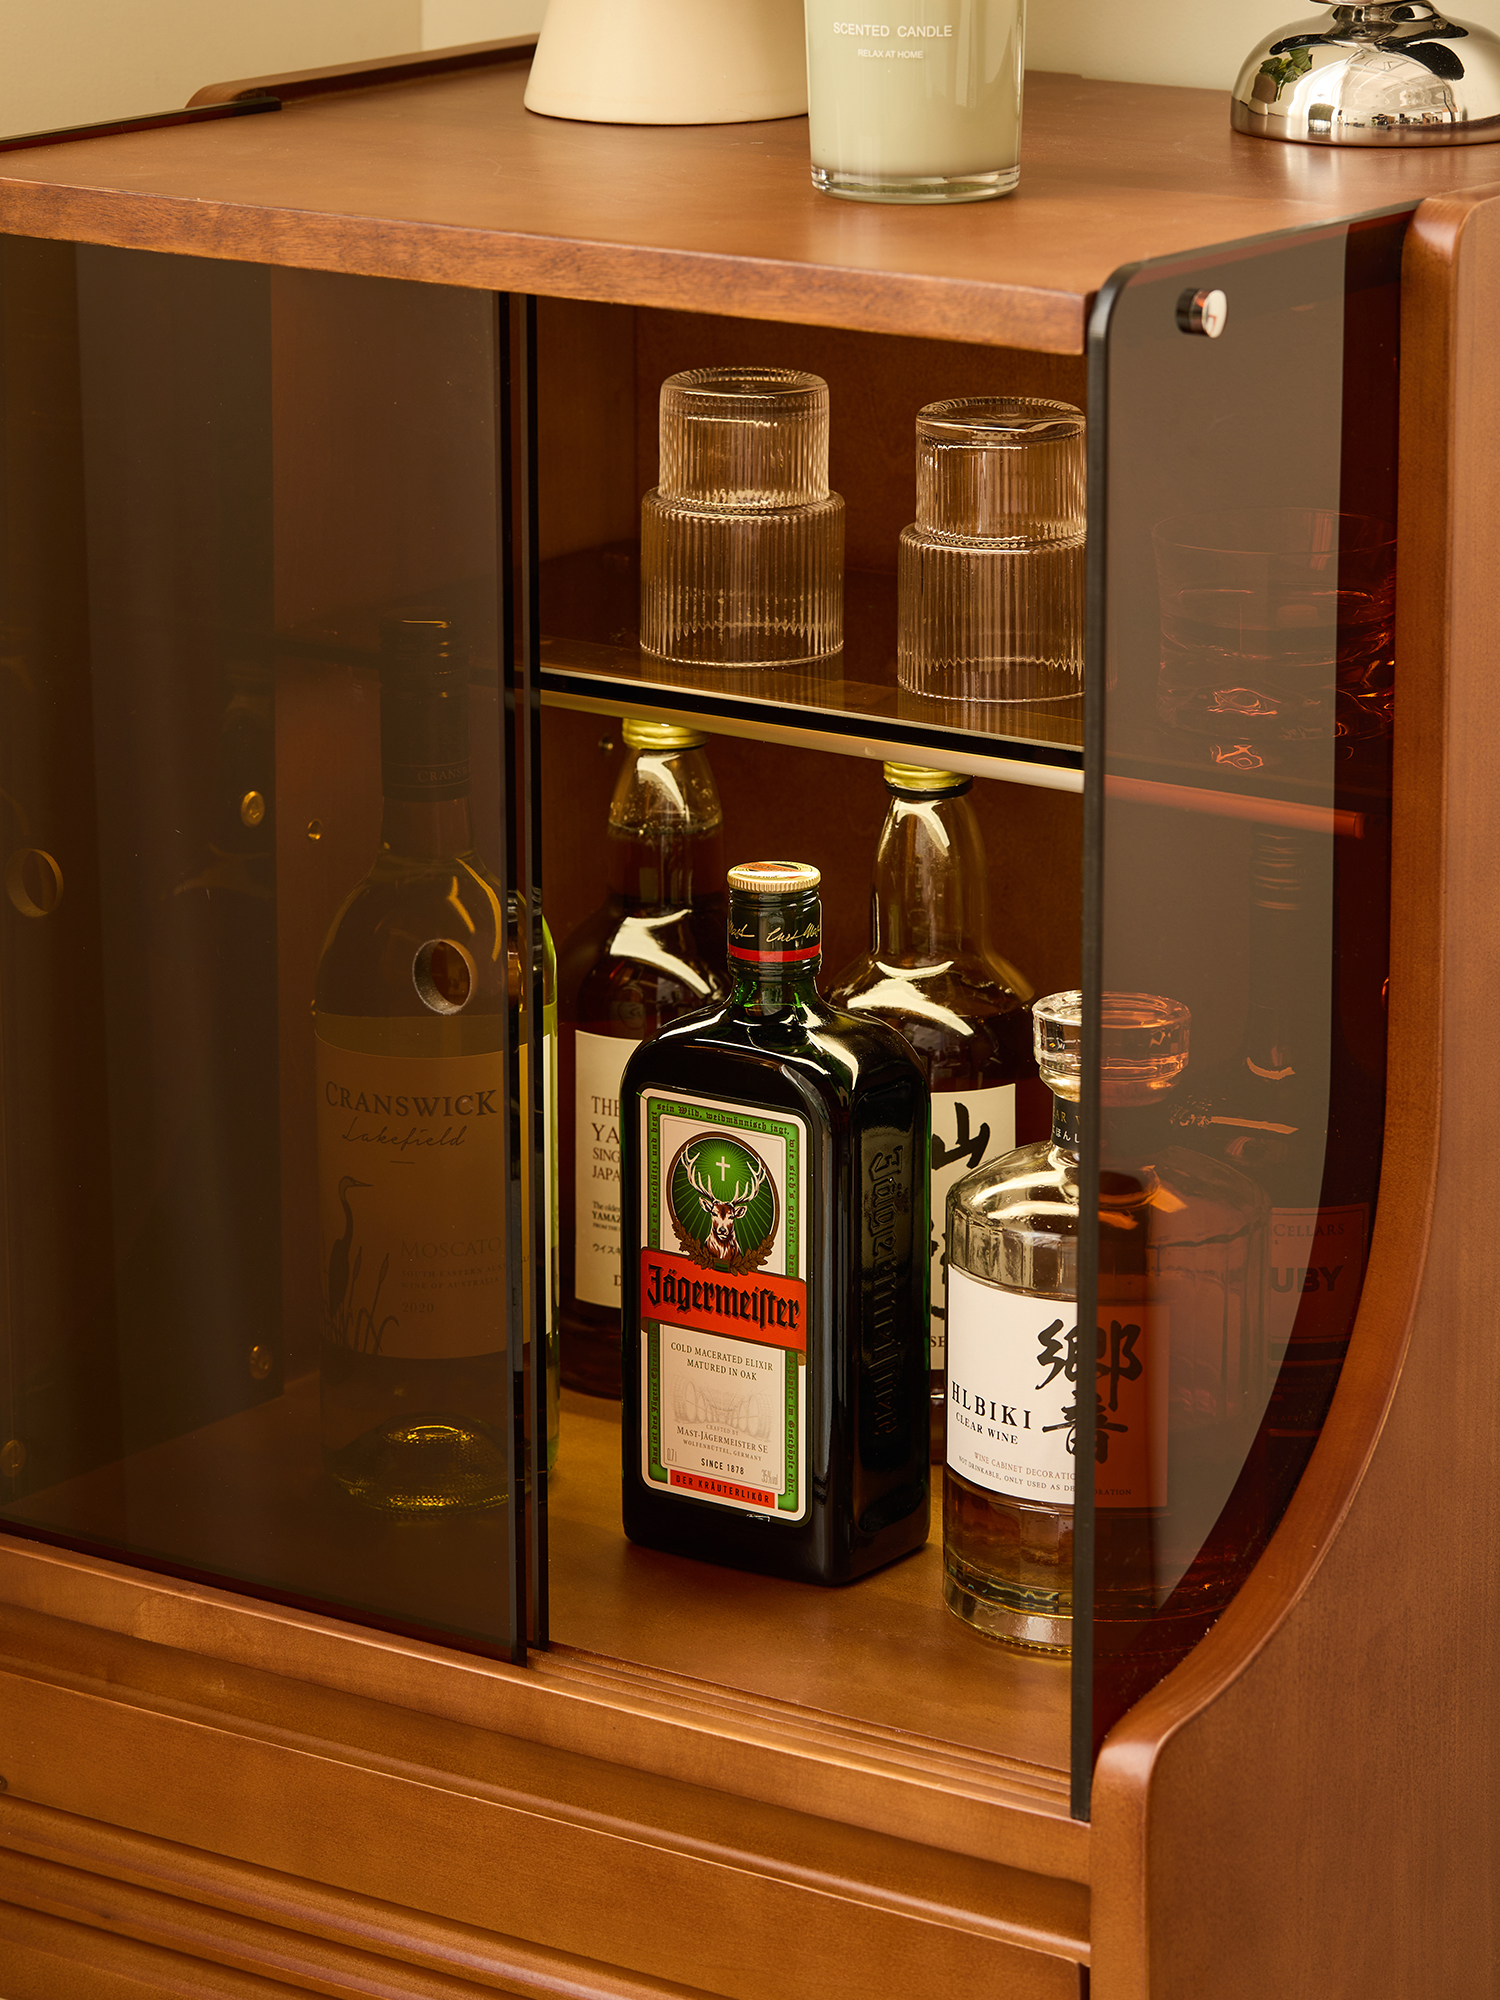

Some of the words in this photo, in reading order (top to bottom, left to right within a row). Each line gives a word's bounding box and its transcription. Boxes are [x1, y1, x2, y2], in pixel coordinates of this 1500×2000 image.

[833, 22, 890, 37] SCENTED
[897, 25, 953, 38] CANDLE
[857, 48, 884, 58] RELAX
[885, 50, 896, 59] AT
[897, 50, 924, 59] HOME
[325, 1081, 498, 1118] CRANSWICK
[656, 1103, 675, 1113] sein
[341, 1116, 468, 1152] Lakefield
[1273, 1222, 1346, 1238] CELLARS
[400, 1236, 502, 1259] MOSCATO
[401, 1270, 435, 1278] SOUTH
[439, 1266, 483, 1278] EASTERN
[448, 1276, 499, 1289] AUSTRALIA
[401, 1301, 435, 1313] 2020
[670, 1341, 693, 1354] COLD
[694, 1346, 743, 1365] MACERATED
[745, 1357, 774, 1371] ELIXIR
[686, 1358, 727, 1375] MATURED
[728, 1367, 739, 1377] IN
[740, 1369, 757, 1381] OAK
[951, 1380, 1032, 1430] HLBIKI
[955, 1411, 984, 1435] CLEAR
[988, 1428, 1019, 1446] WINE
[733, 1450, 762, 1462] GERMANY
[757, 1443, 769, 1454] SE
[701, 1457, 724, 1471] SINCE
[727, 1460, 745, 1475] 1878
[958, 1455, 967, 1465] NOT
[967, 1460, 1002, 1481] DRINKABLE,
[1003, 1474, 1023, 1485] ONLY
[1026, 1479, 1046, 1489] USED
[974, 1451, 990, 1466] WINE
[991, 1458, 1023, 1474] CABINET
[675, 1474, 693, 1486] DER
[698, 1478, 770, 1504] KRÄUTERLIKÖR
